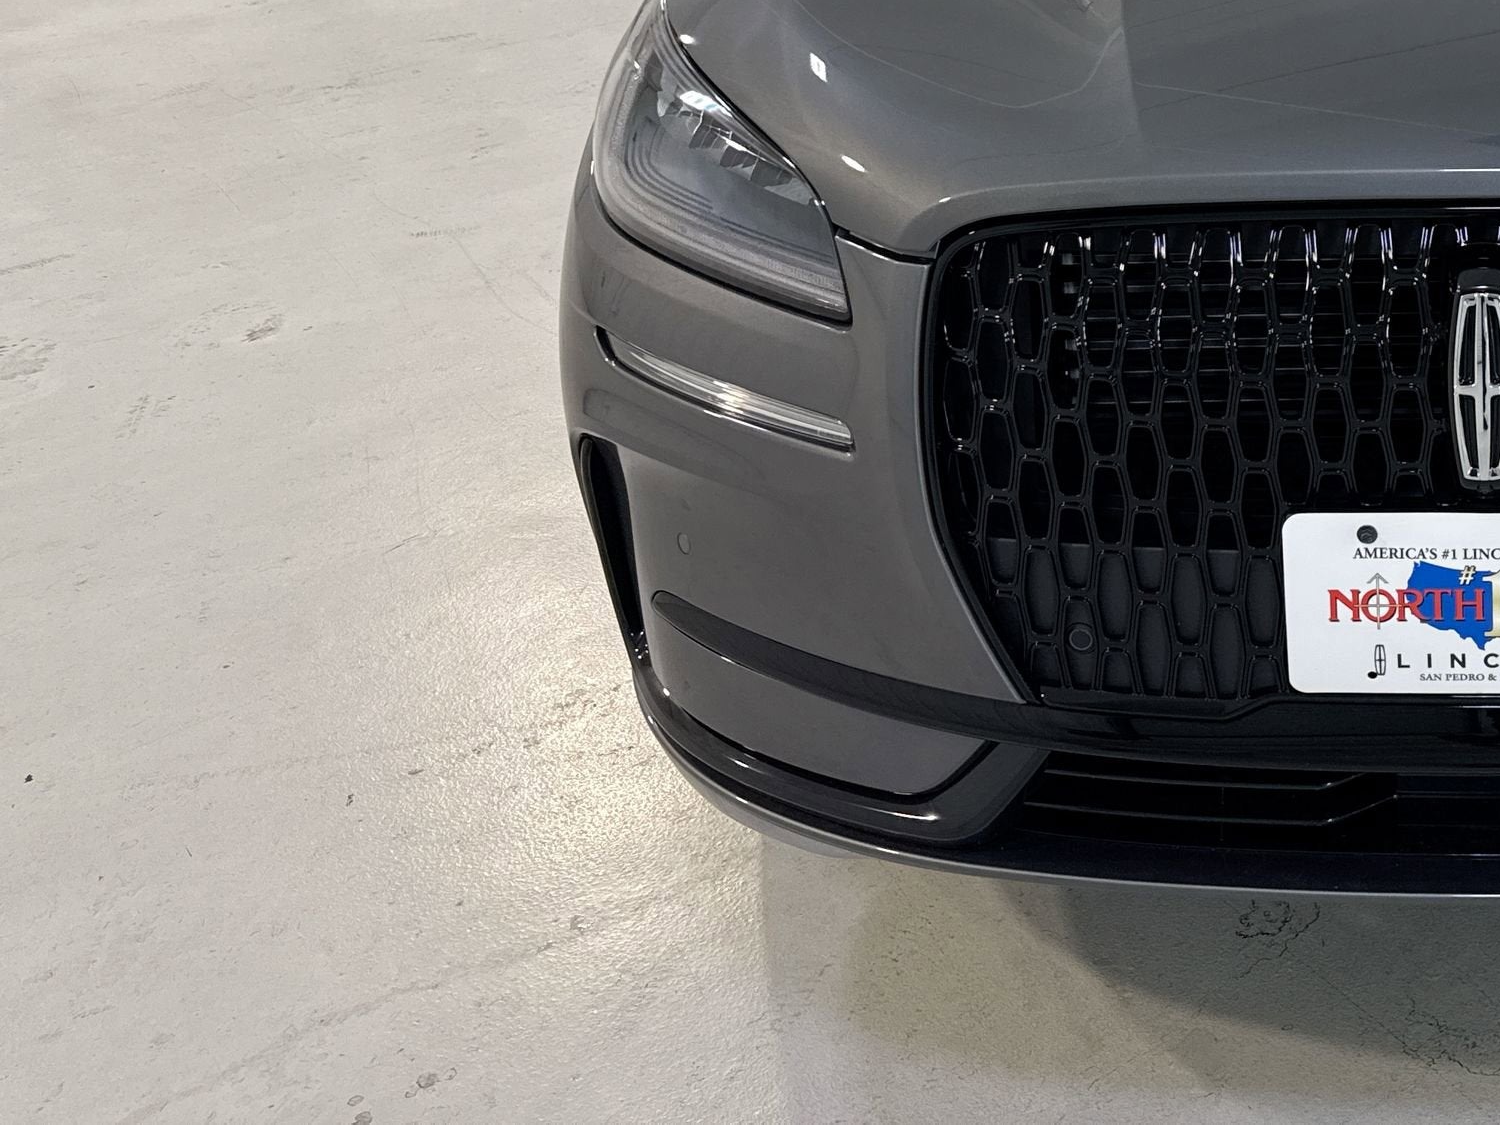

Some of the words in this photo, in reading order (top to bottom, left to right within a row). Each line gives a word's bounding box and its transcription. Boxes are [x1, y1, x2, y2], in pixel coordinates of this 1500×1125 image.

[1353, 547, 1438, 560] AMERICA'S
[1441, 547, 1457, 560] #1
[1327, 587, 1485, 623] NORTH
[1419, 673, 1444, 682] SAN
[1445, 673, 1485, 682] PEDRO
[1487, 673, 1498, 682] &
